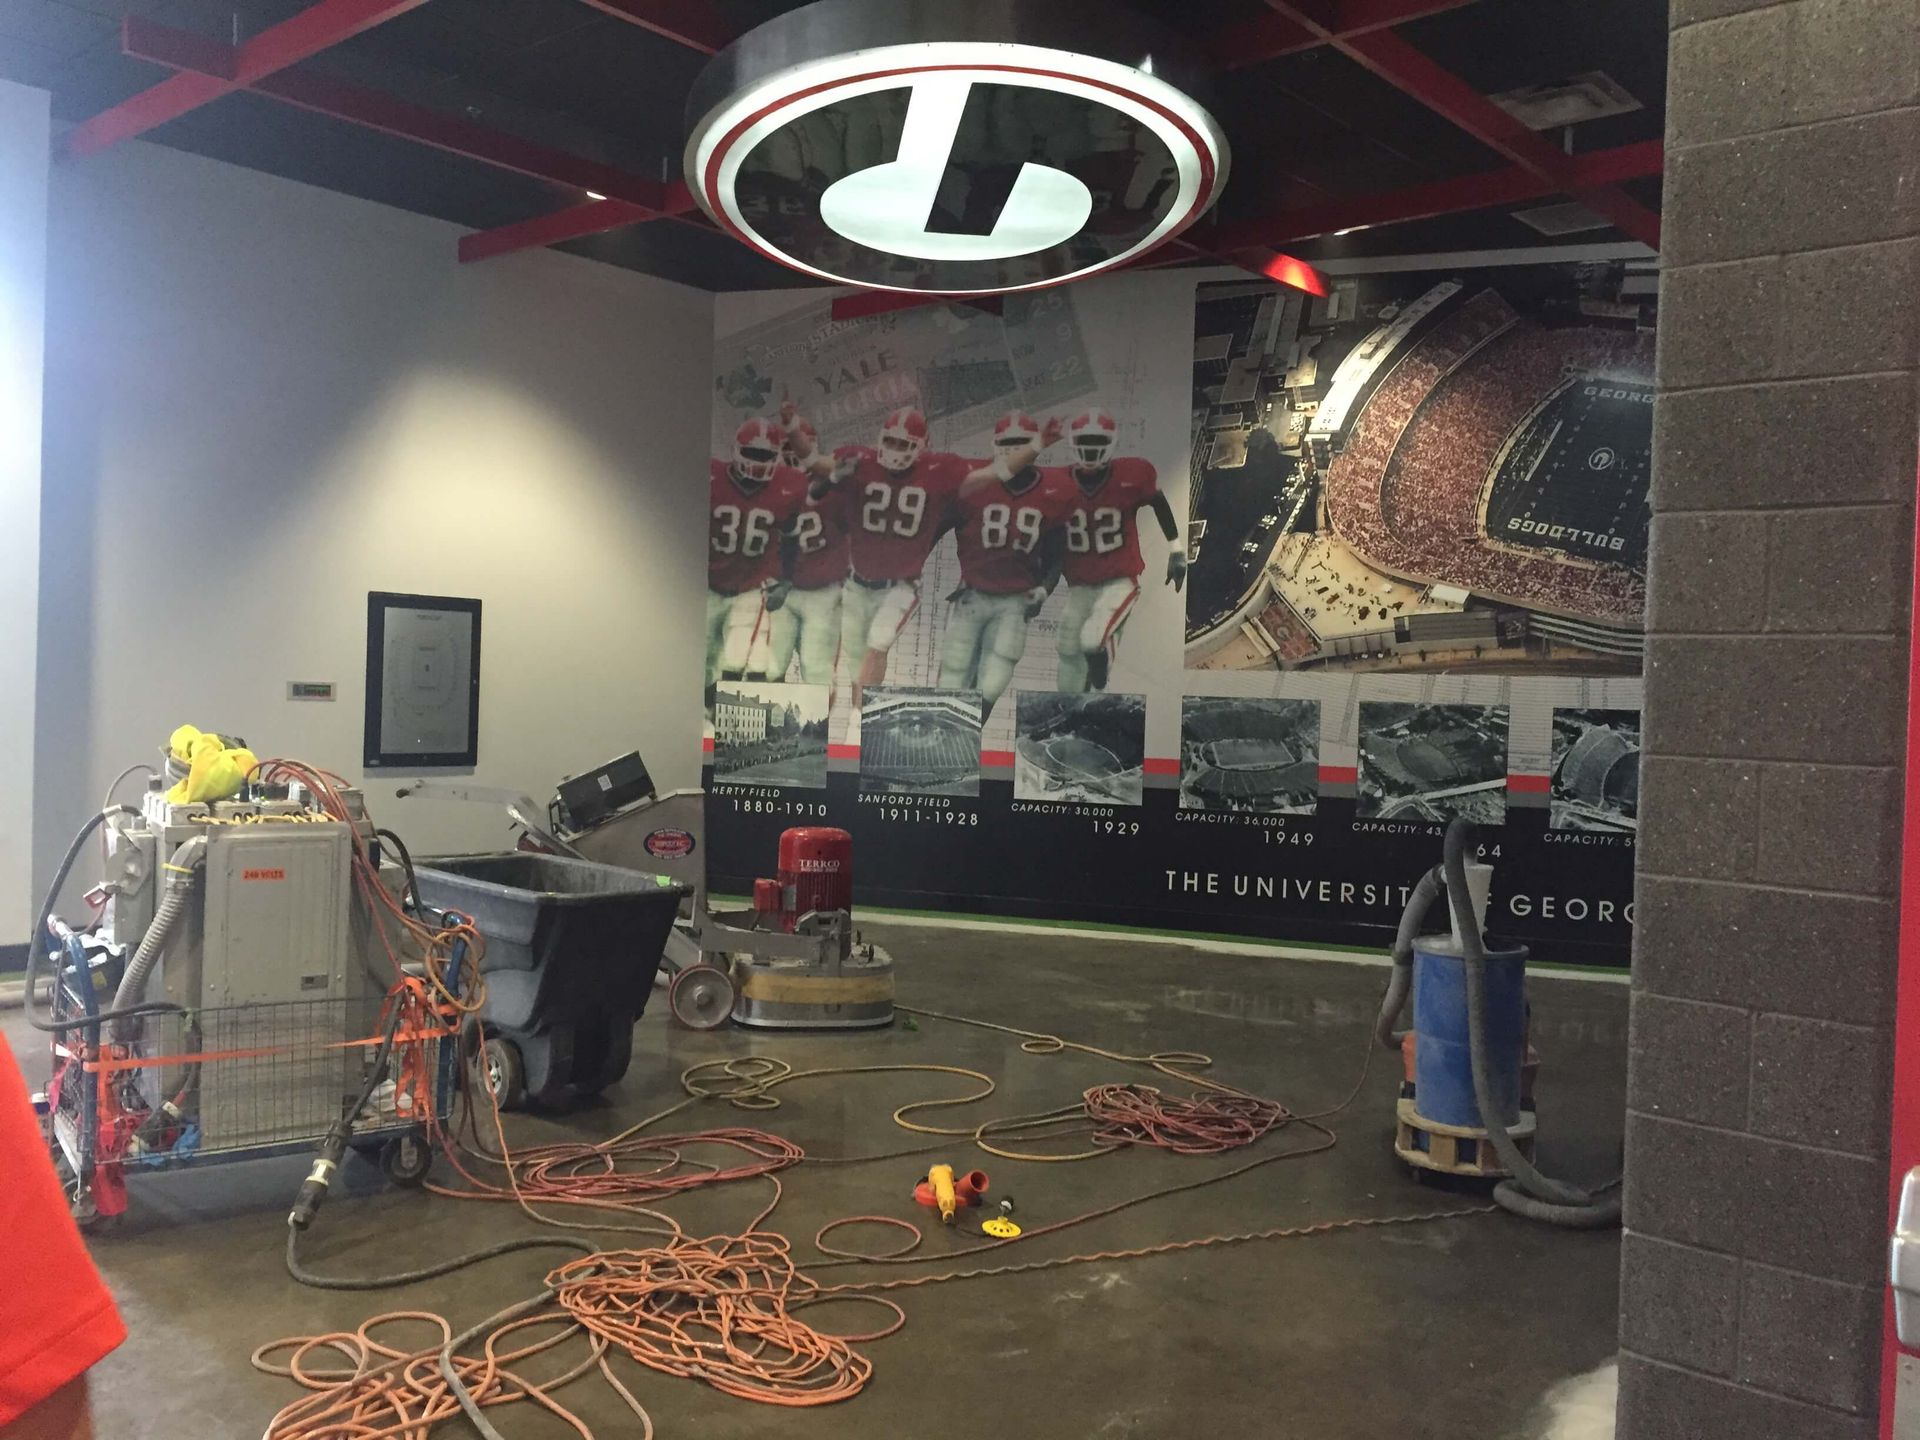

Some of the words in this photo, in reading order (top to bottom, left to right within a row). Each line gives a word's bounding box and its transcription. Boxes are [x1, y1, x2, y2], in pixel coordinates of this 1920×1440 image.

[814, 351, 897, 394] YALE
[862, 481, 927, 538] 29
[711, 504, 776, 557] 36
[981, 503, 1043, 554] 89
[1065, 507, 1123, 554] 82
[1507, 517, 1625, 550] BULLDOGS
[711, 786, 747, 796] HERTY
[749, 787, 781, 798] FIELD
[857, 793, 913, 806] SANFORD
[916, 796, 951, 808] FIELD
[733, 799, 828, 817] 1880-1910
[879, 807, 979, 826] 1911-1928
[1011, 802, 1071, 815] CAPACITY:
[1074, 805, 1114, 818] 30,000
[1092, 820, 1141, 836] 1929
[1243, 815, 1286, 827] 36,000
[1352, 822, 1422, 835] CAPACITY:
[1425, 826, 1444, 837] 43,
[1263, 830, 1315, 846] 1949
[1476, 843, 1501, 858] 64
[799, 858, 840, 868] TERRCO
[1166, 870, 1219, 894] THE
[1234, 875, 1411, 908] UNIVERSIT
